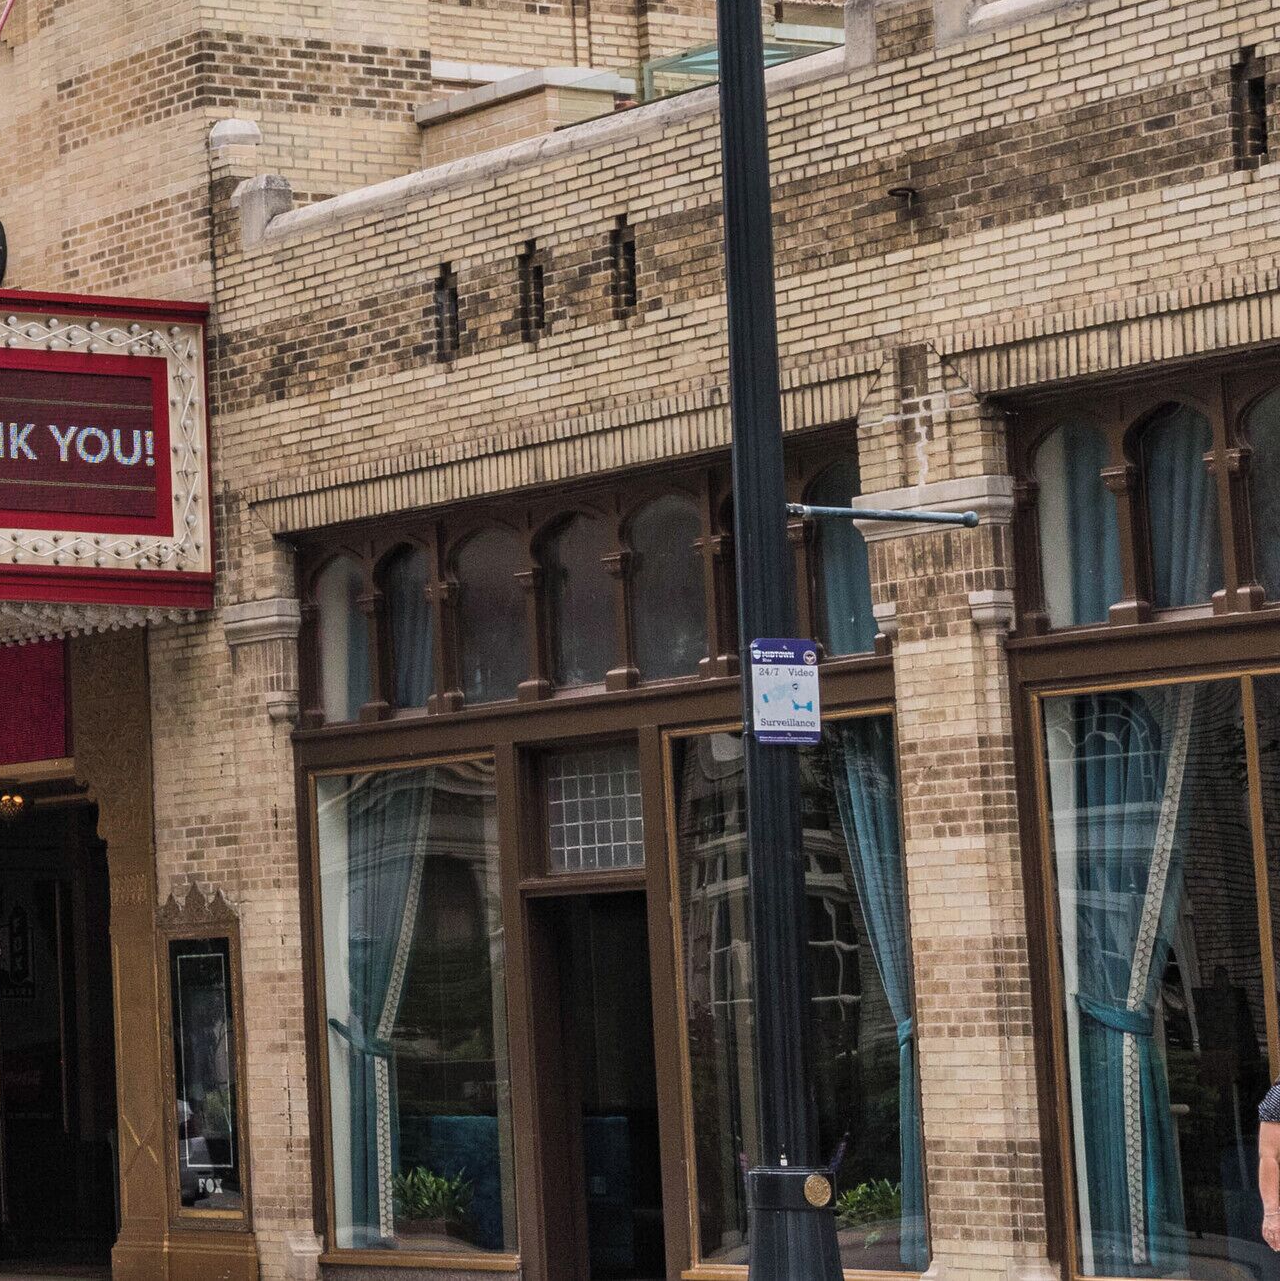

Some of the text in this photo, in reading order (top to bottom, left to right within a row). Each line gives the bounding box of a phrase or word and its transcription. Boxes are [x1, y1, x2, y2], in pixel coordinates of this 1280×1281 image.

[48, 425, 156, 467] YOU!
[762, 650, 794, 659] MIDTOWN
[759, 667, 814, 677] 24/7 Video
[760, 718, 816, 727] Surveillance
[199, 1178, 223, 1194] FOX
